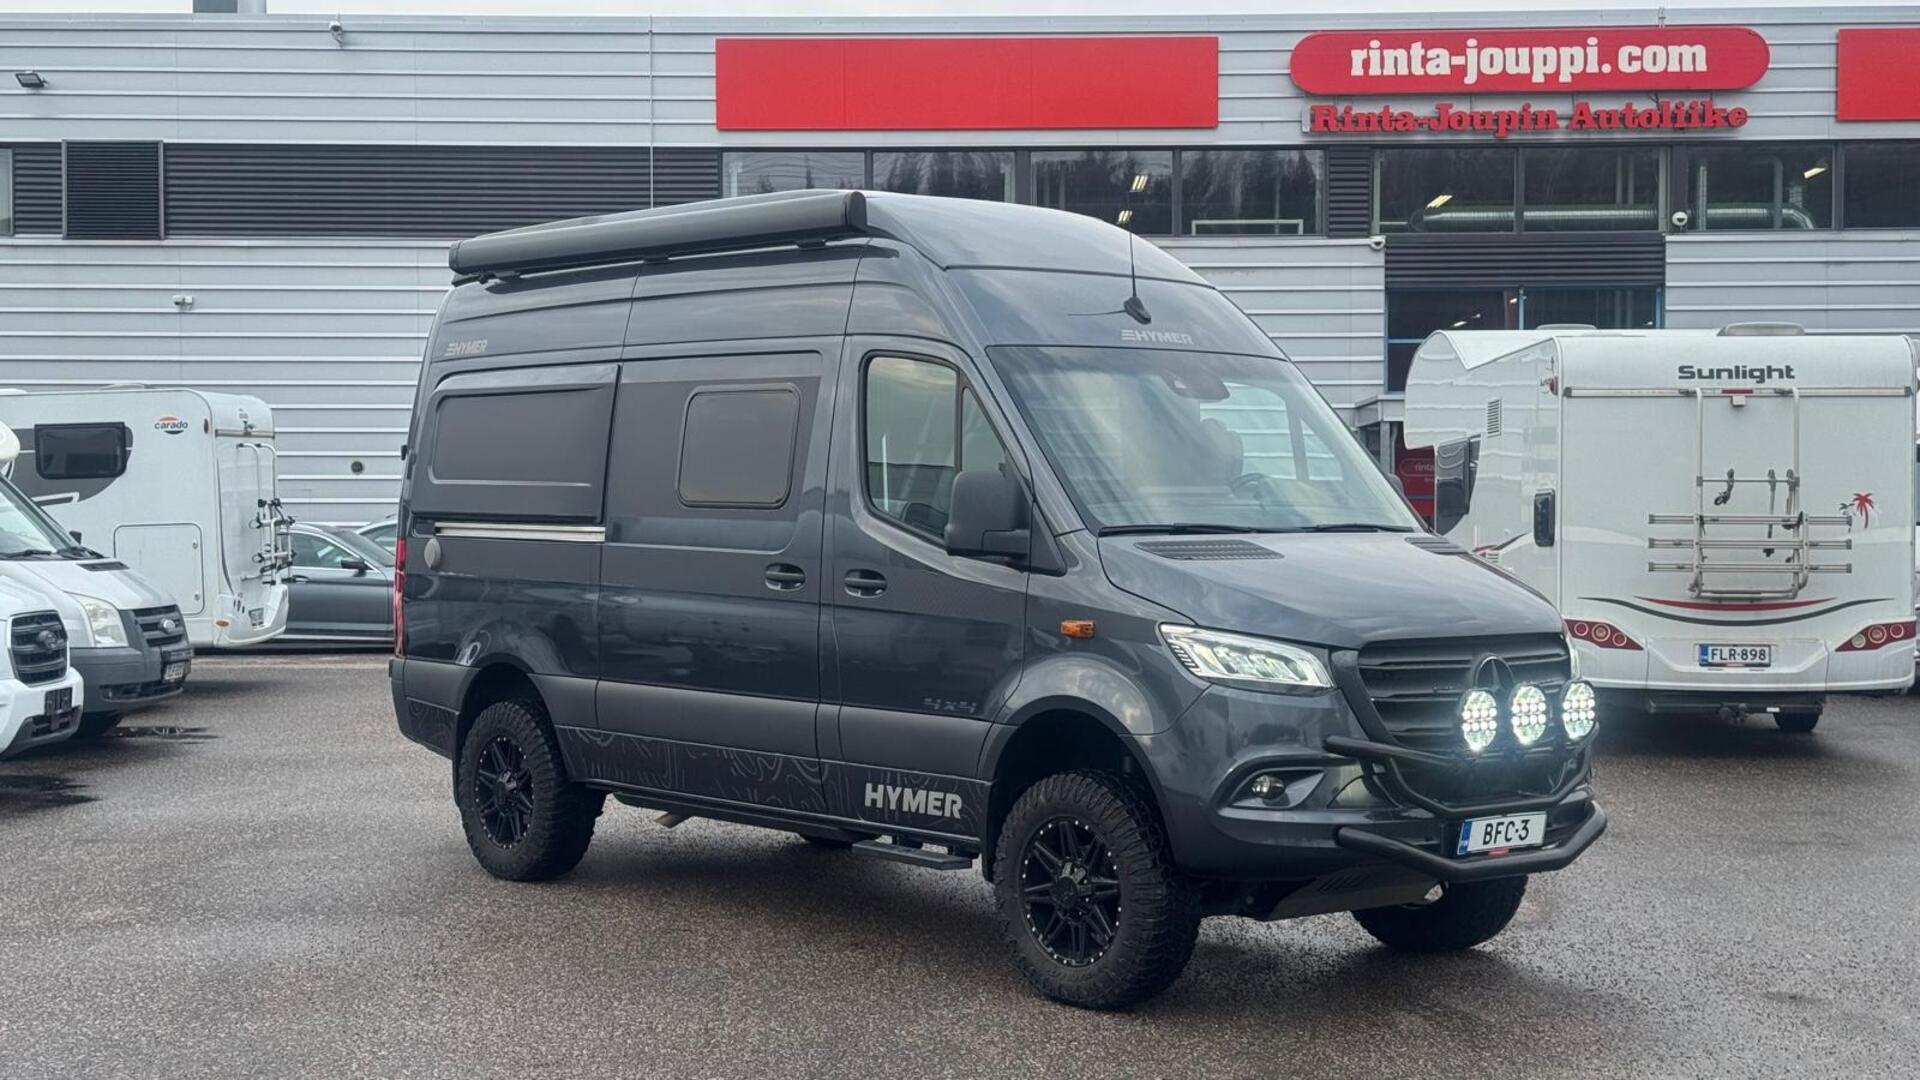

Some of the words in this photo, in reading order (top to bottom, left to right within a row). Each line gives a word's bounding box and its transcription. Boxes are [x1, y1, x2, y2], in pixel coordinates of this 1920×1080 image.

[1310, 102, 1560, 138] Rinta-Joupin
[1568, 99, 1749, 131] Autoliike
[1678, 365, 1796, 384] Sunlight
[154, 420, 189, 430] carado
[1711, 647, 1767, 661] FLR-898
[864, 782, 963, 819] HYMER
[1482, 819, 1531, 846] BFC-3
